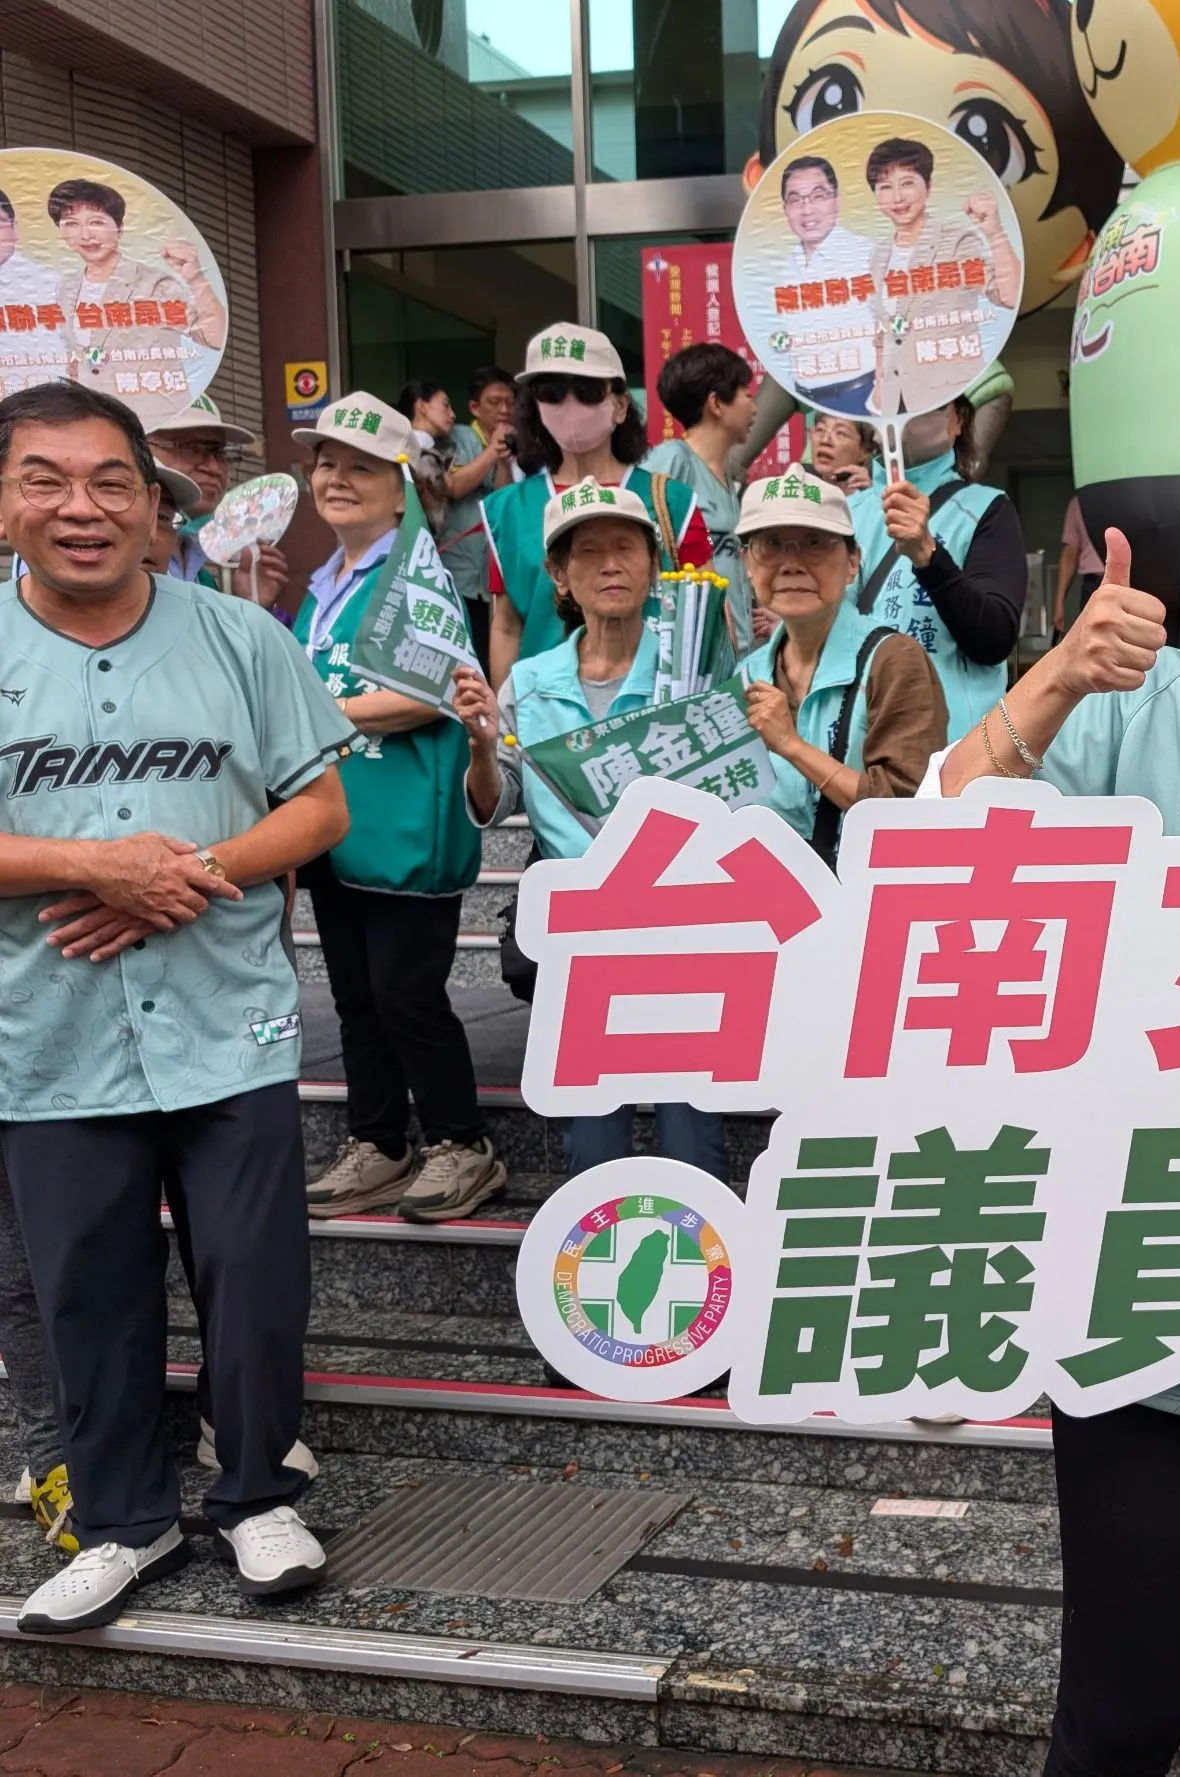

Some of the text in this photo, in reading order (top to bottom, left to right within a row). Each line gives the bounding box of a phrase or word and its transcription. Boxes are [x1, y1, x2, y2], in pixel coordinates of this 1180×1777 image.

[0, 303, 66, 333] 聯手
[335, 407, 383, 435] 陳金鐘
[562, 484, 617, 513] 陳金鐘
[762, 474, 822, 504] 陳金鐘
[325, 643, 351, 697] 服務
[0, 734, 235, 800] TAINAN
[581, 692, 751, 809] 陳金鐘
[562, 1196, 725, 1263] 民主進步黨
[556, 1271, 729, 1364] DEMOCRATIC PROGRESSIVE PARTY
